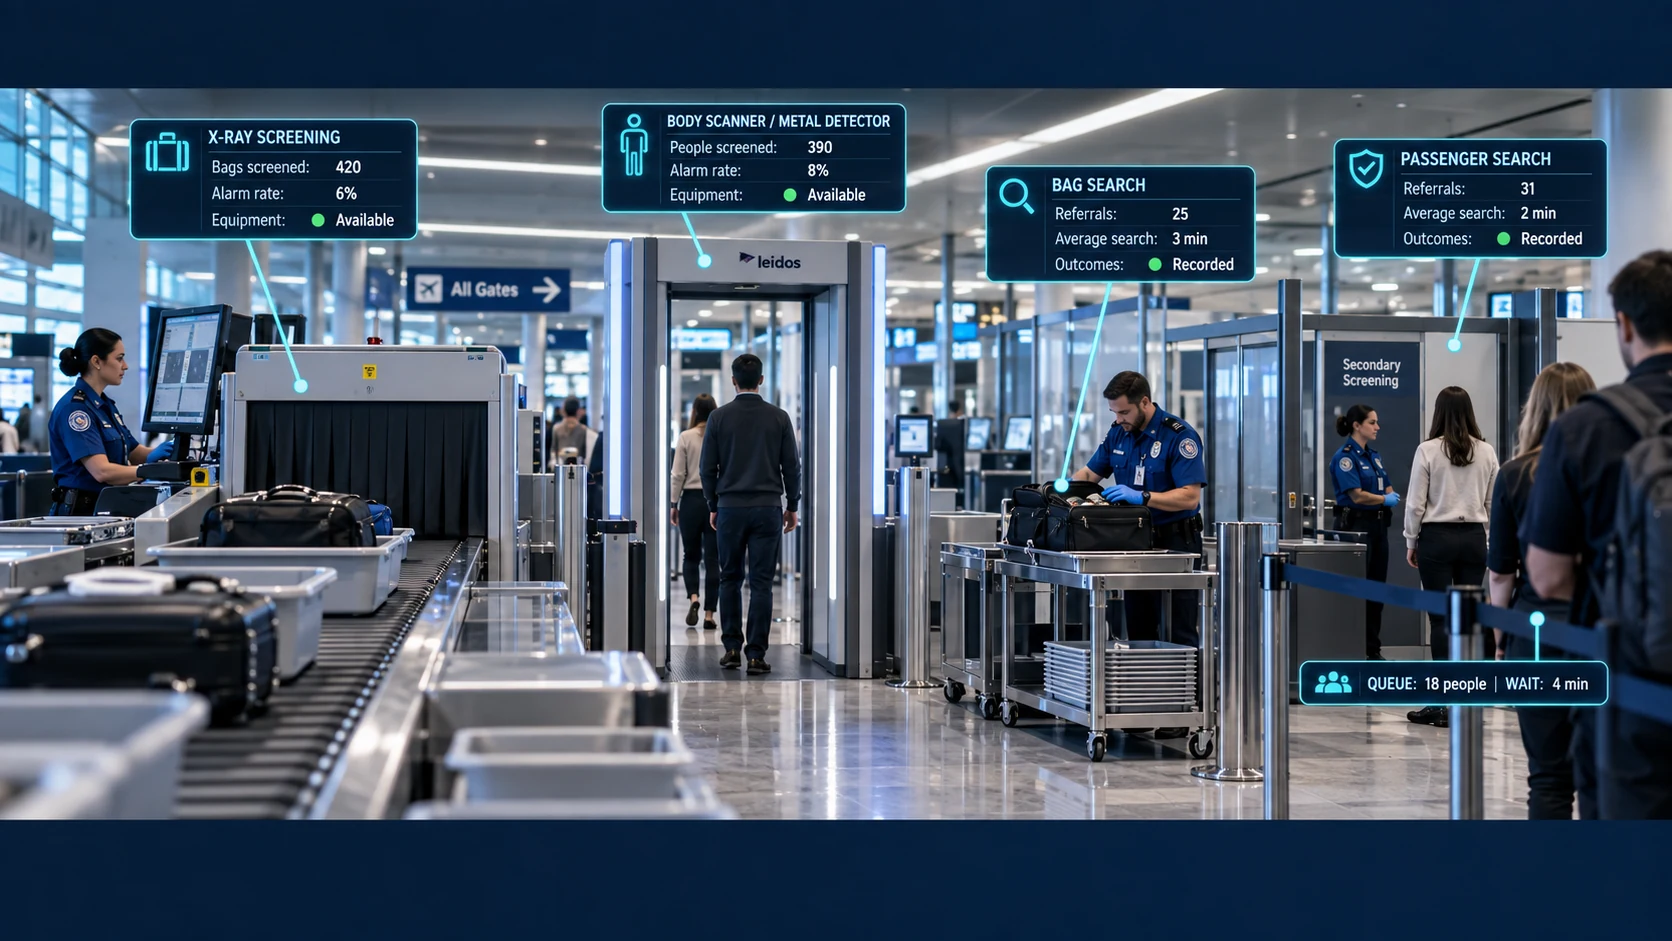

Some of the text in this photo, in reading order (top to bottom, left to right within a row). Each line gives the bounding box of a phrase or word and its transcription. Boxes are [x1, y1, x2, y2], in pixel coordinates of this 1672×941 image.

[758, 255, 801, 268] leidos
[451, 281, 519, 297] All Gates
[1343, 358, 1401, 373] Secondary
[1343, 373, 1400, 390] Screening
